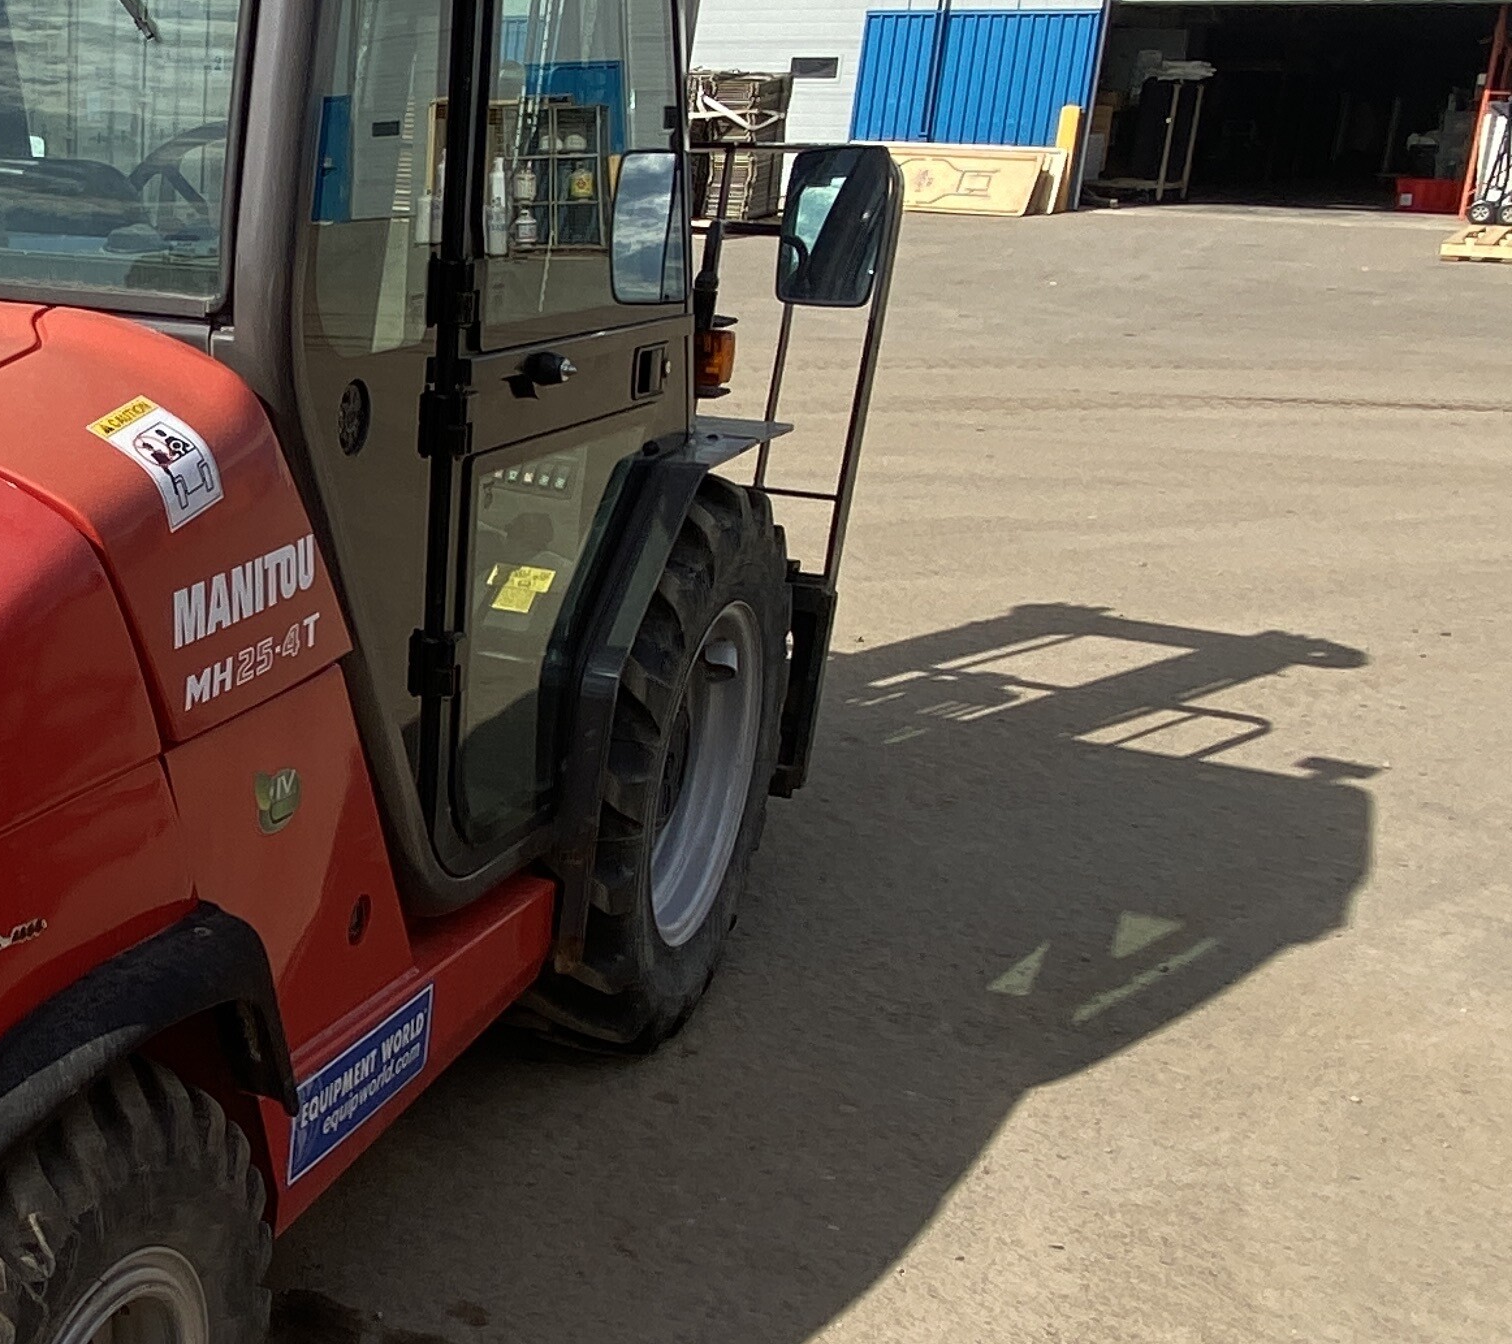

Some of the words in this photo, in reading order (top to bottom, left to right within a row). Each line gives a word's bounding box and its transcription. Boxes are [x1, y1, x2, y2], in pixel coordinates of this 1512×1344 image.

[107, 402, 152, 428] CAUTION
[173, 533, 315, 650] MANITOU
[300, 1048, 378, 1129] EQUIPMENT
[381, 1012, 426, 1064] WORLD
[322, 1042, 421, 1135] equipworld.com
